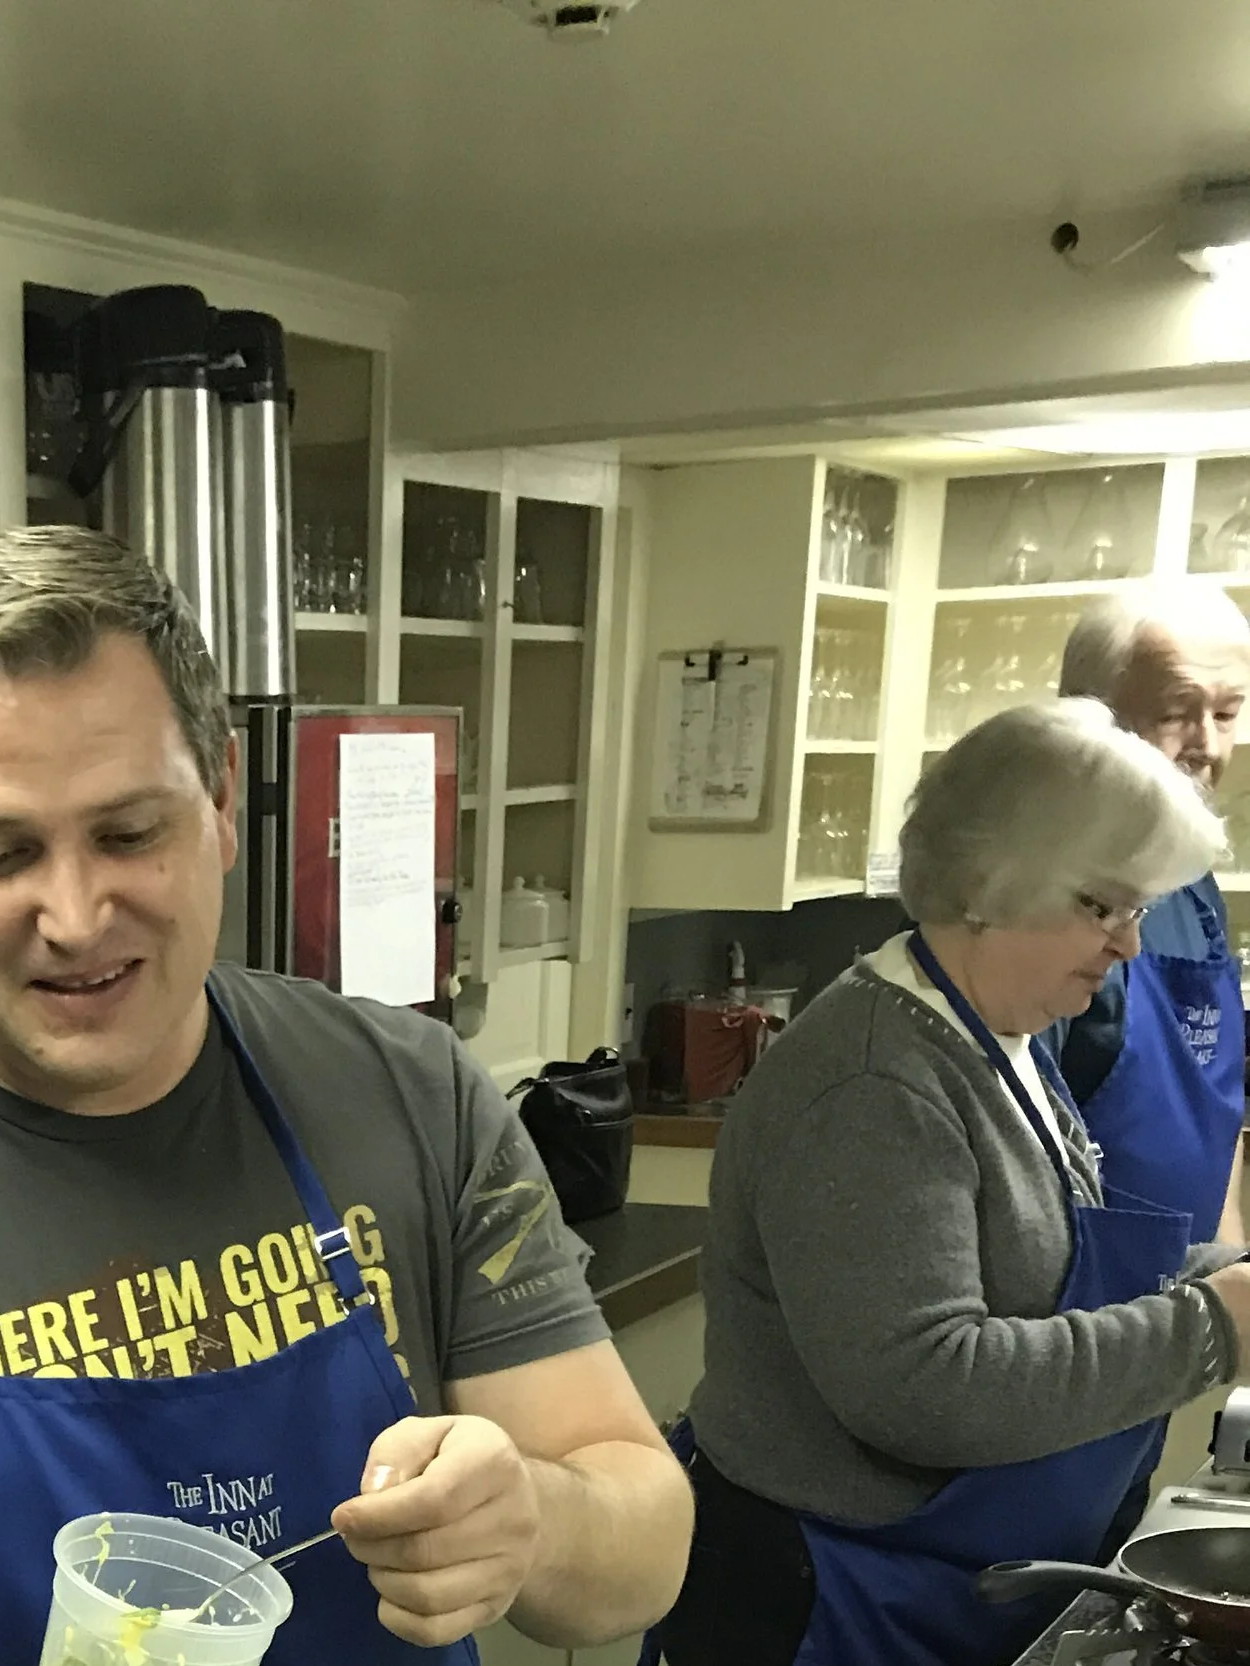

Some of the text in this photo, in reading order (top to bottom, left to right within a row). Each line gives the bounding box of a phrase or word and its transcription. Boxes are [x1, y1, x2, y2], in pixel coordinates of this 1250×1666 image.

[116, 1259, 208, 1341] I'M
[166, 1481, 204, 1508] THE
[201, 1473, 258, 1515] INN
[200, 1505, 282, 1550] ASANT
